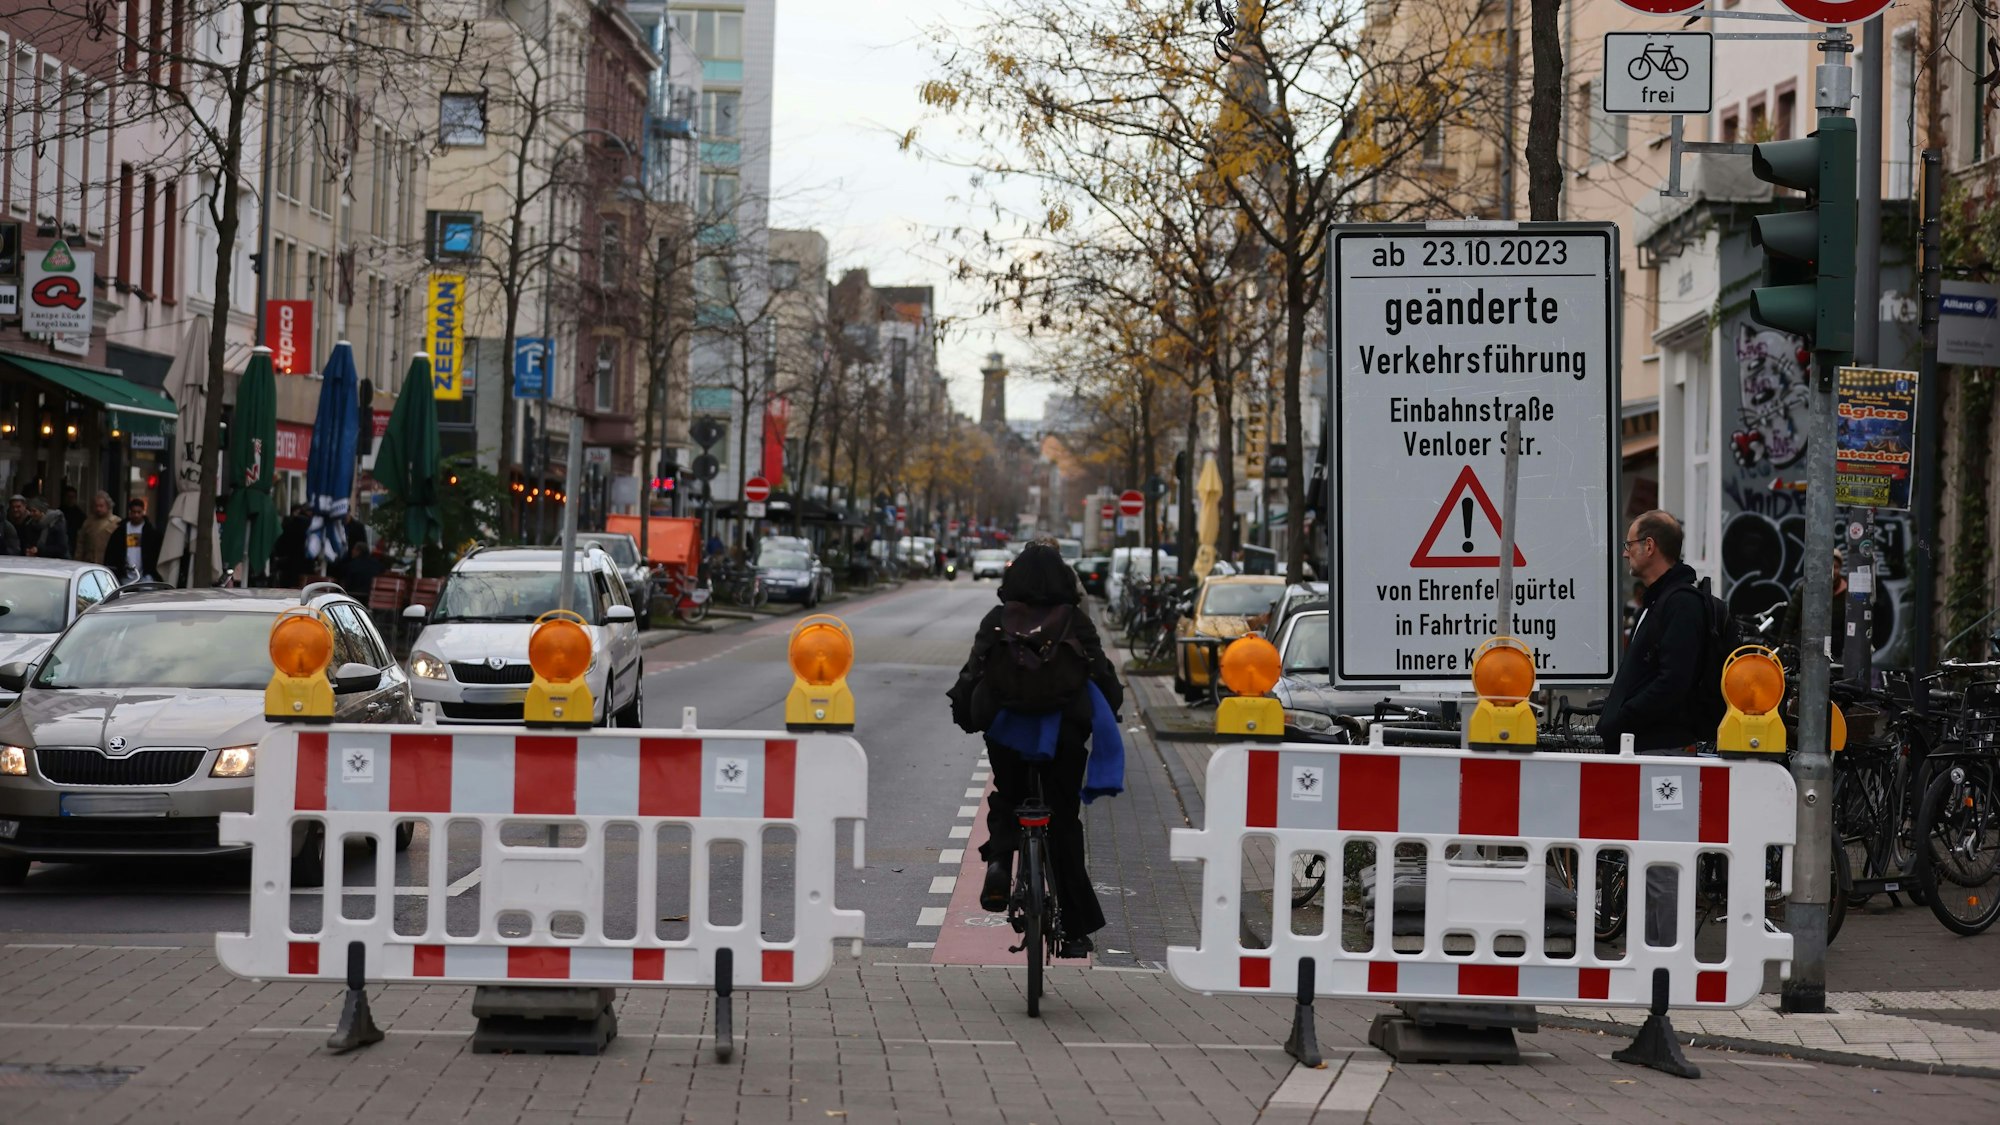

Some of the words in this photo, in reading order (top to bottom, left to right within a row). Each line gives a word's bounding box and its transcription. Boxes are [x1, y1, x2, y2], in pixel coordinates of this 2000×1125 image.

[1642, 87, 1674, 103] frei
[1373, 241, 1404, 266] ab
[1423, 240, 1567, 266] 23.10.2023
[1386, 287, 1557, 335] geänderte
[1943, 299, 1973, 310] Allianz
[275, 305, 296, 368] tipico
[435, 281, 457, 390] ZEEMAN
[1360, 344, 1585, 380] Verkehrsführung
[1391, 397, 1553, 422] Einbahnstraße
[1404, 431, 1491, 456] Venloer
[1377, 585, 1411, 600] von
[1419, 578, 1575, 608] Ehrenfelgürtel
[1397, 614, 1412, 635] in
[1420, 612, 1555, 640] Fahrtrictung
[1397, 649, 1456, 670] Innere
